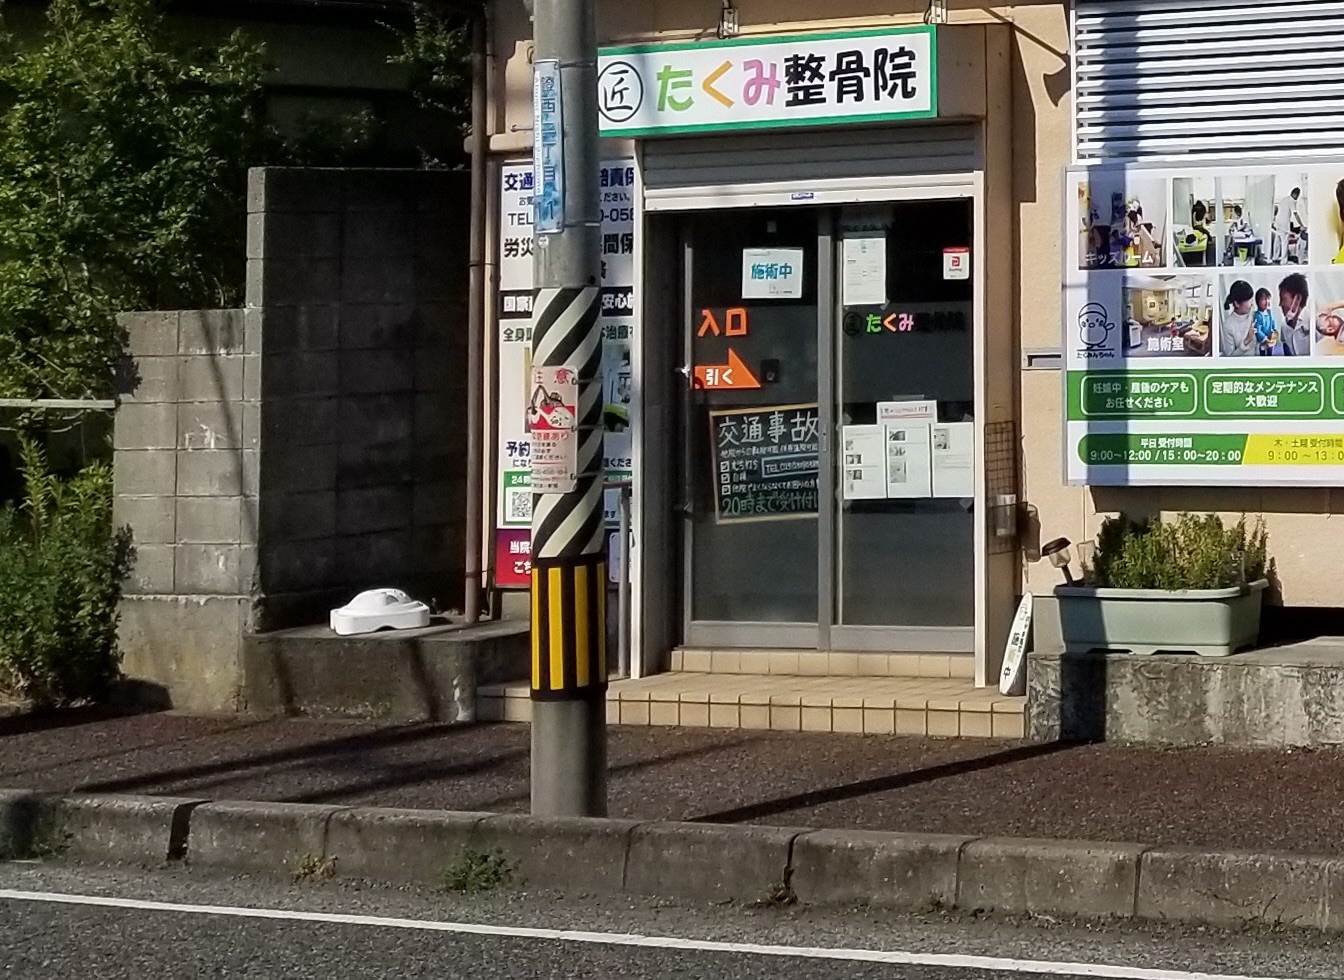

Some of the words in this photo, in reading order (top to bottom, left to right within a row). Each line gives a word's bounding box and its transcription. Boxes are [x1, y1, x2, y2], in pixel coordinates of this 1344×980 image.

[656, 46, 918, 112] たくみ整骨院
[751, 262, 794, 280] 施術中
[697, 307, 748, 338] 入口
[705, 368, 734, 387] 引く
[1211, 380, 1319, 394] 定期的なメンテナンス
[1106, 396, 1174, 409] お任せください
[1245, 394, 1279, 408] 大歓迎
[718, 409, 819, 448] 交通事故
